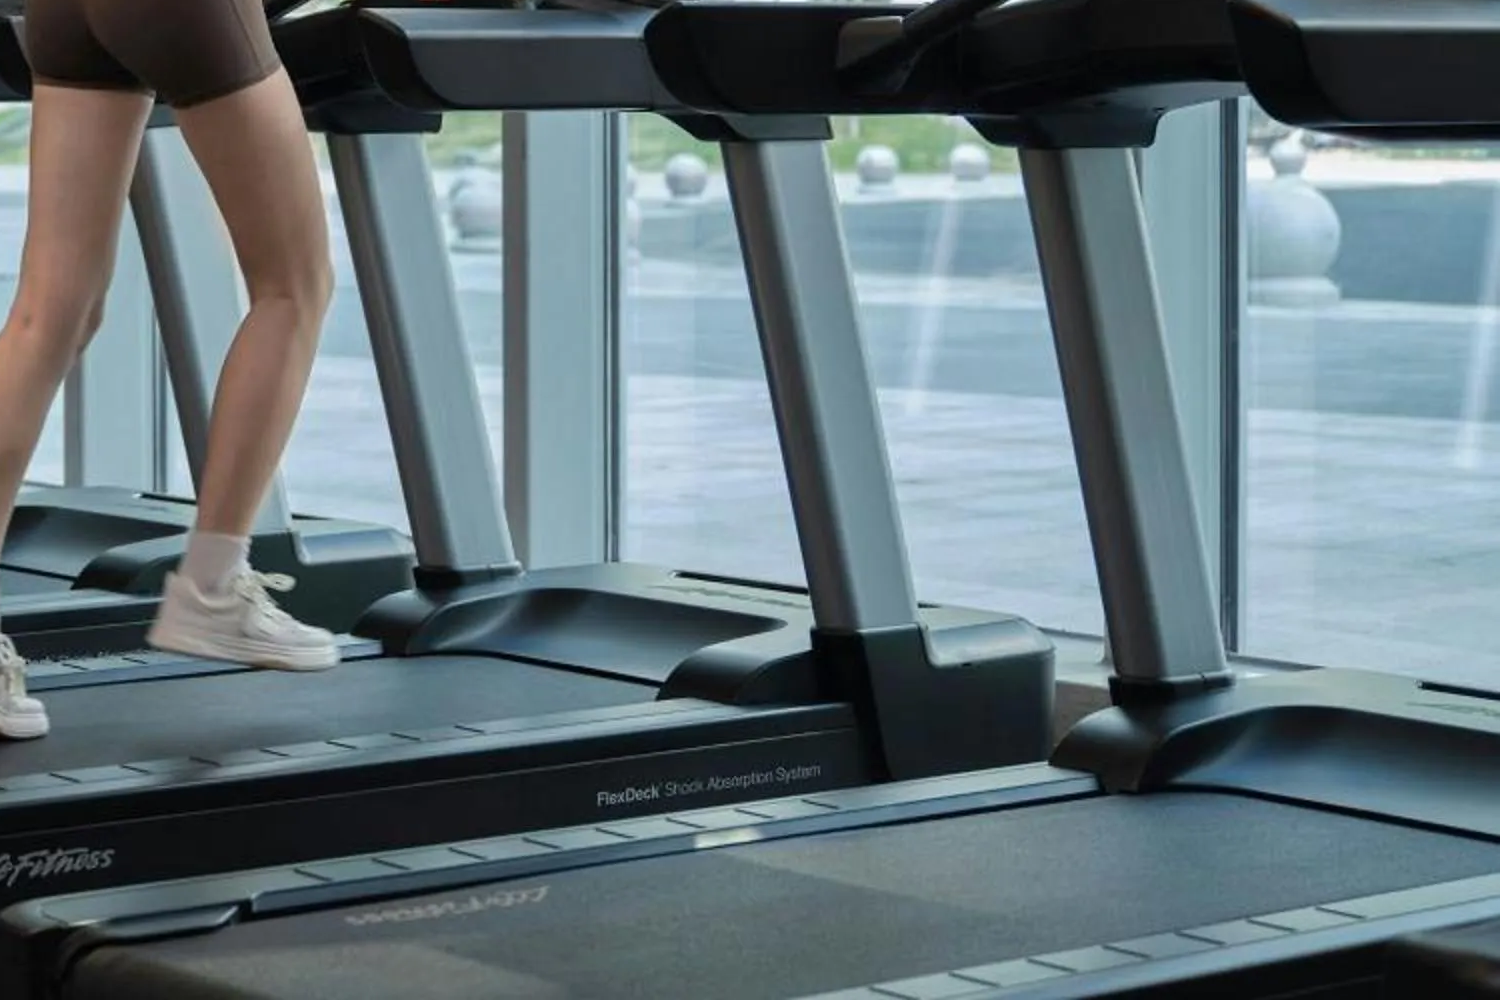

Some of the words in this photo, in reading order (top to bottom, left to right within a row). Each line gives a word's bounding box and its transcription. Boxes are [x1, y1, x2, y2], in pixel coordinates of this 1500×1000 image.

[597, 784, 660, 807] FlexDeck
[664, 780, 703, 796] Shock
[707, 771, 773, 791] Absorption
[775, 765, 821, 783] System
